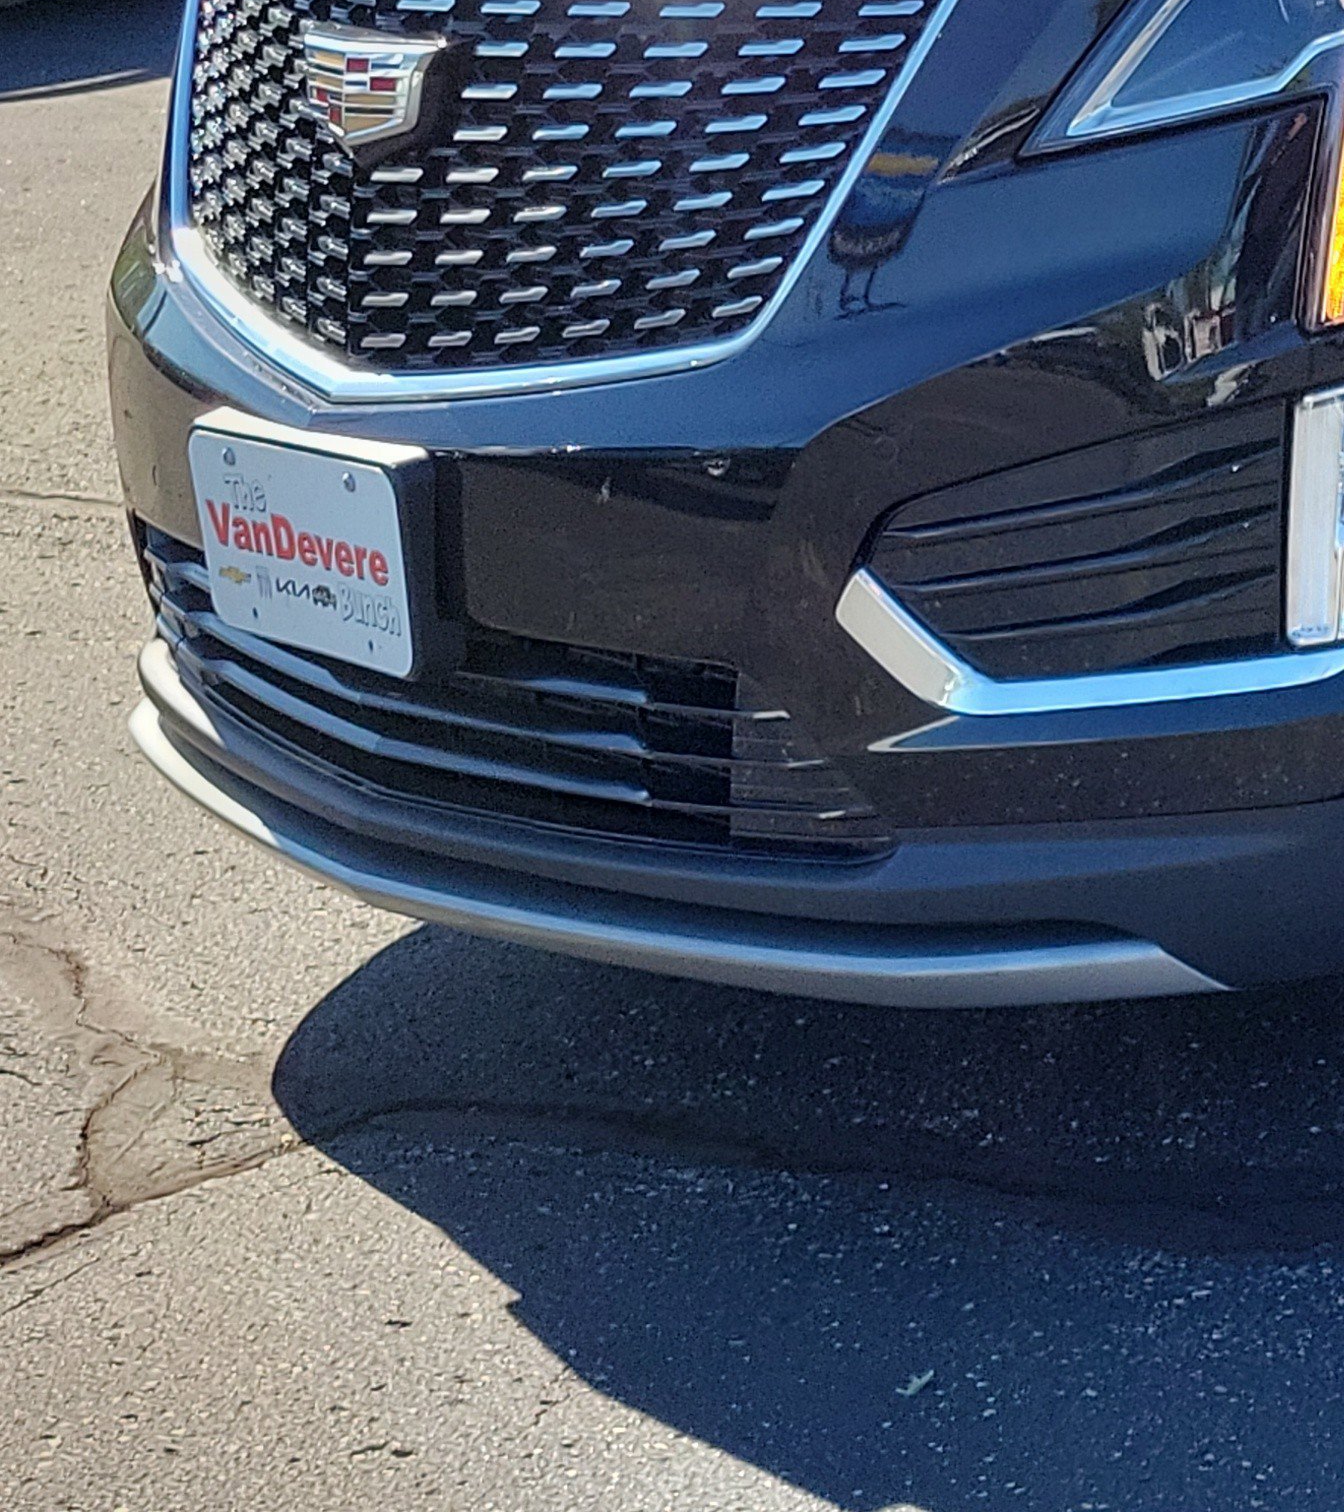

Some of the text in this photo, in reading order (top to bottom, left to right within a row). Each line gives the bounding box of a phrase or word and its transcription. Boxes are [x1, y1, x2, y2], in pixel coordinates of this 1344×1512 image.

[223, 473, 267, 513] The
[206, 499, 389, 586] VanDevere
[338, 581, 402, 637] Bunch
